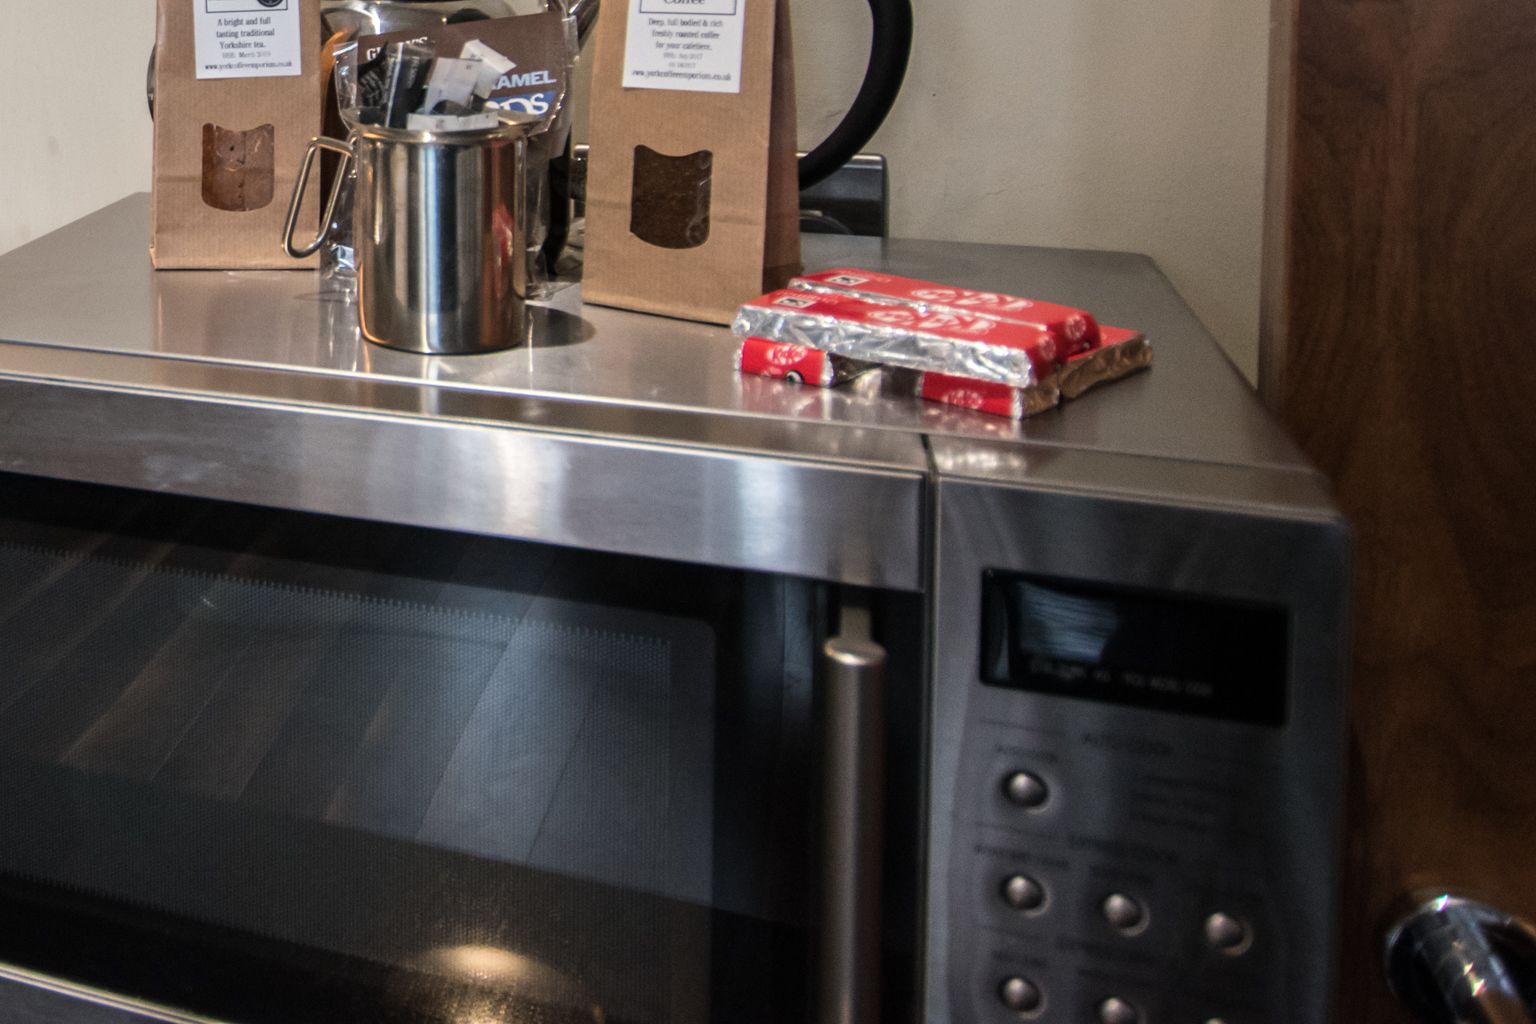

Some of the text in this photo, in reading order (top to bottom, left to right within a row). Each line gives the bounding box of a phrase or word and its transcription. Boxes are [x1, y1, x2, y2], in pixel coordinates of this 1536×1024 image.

[217, 18, 223, 26] A
[224, 18, 244, 27] bright
[259, 17, 271, 25] full
[216, 28, 275, 39] tasting traditional
[219, 40, 252, 49] Yorkshire
[492, 70, 557, 90] AMEL
